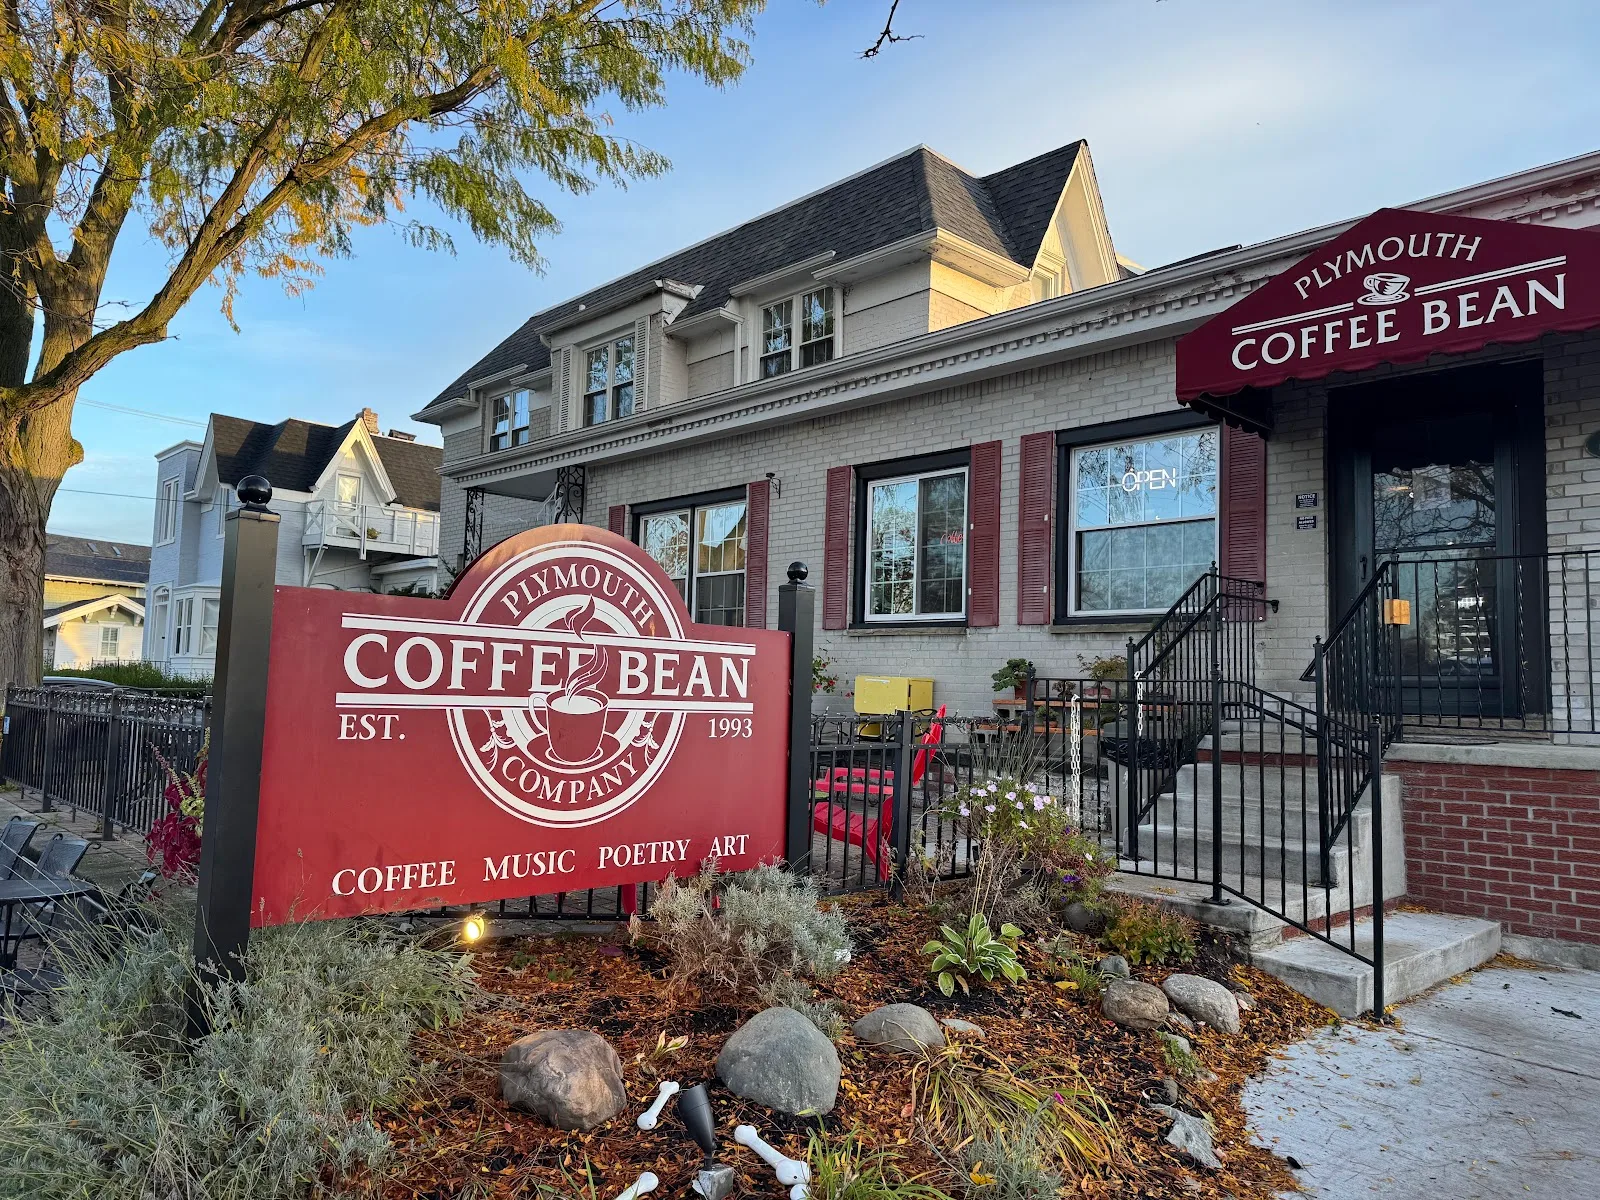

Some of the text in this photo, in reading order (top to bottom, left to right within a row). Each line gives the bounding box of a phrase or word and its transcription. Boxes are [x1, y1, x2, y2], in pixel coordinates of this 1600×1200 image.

[1293, 232, 1482, 300] PLYMOUTH
[1231, 273, 1567, 371] COFFEE BEAN
[1122, 467, 1176, 492] OPEN
[501, 563, 655, 629] PLYMOUTH
[616, 649, 751, 699] BEAN
[337, 713, 406, 741] EST.
[708, 717, 753, 739] 1993
[501, 751, 638, 804] COMPANY
[331, 834, 750, 896] COFFEE MUSIC POETRY ART
